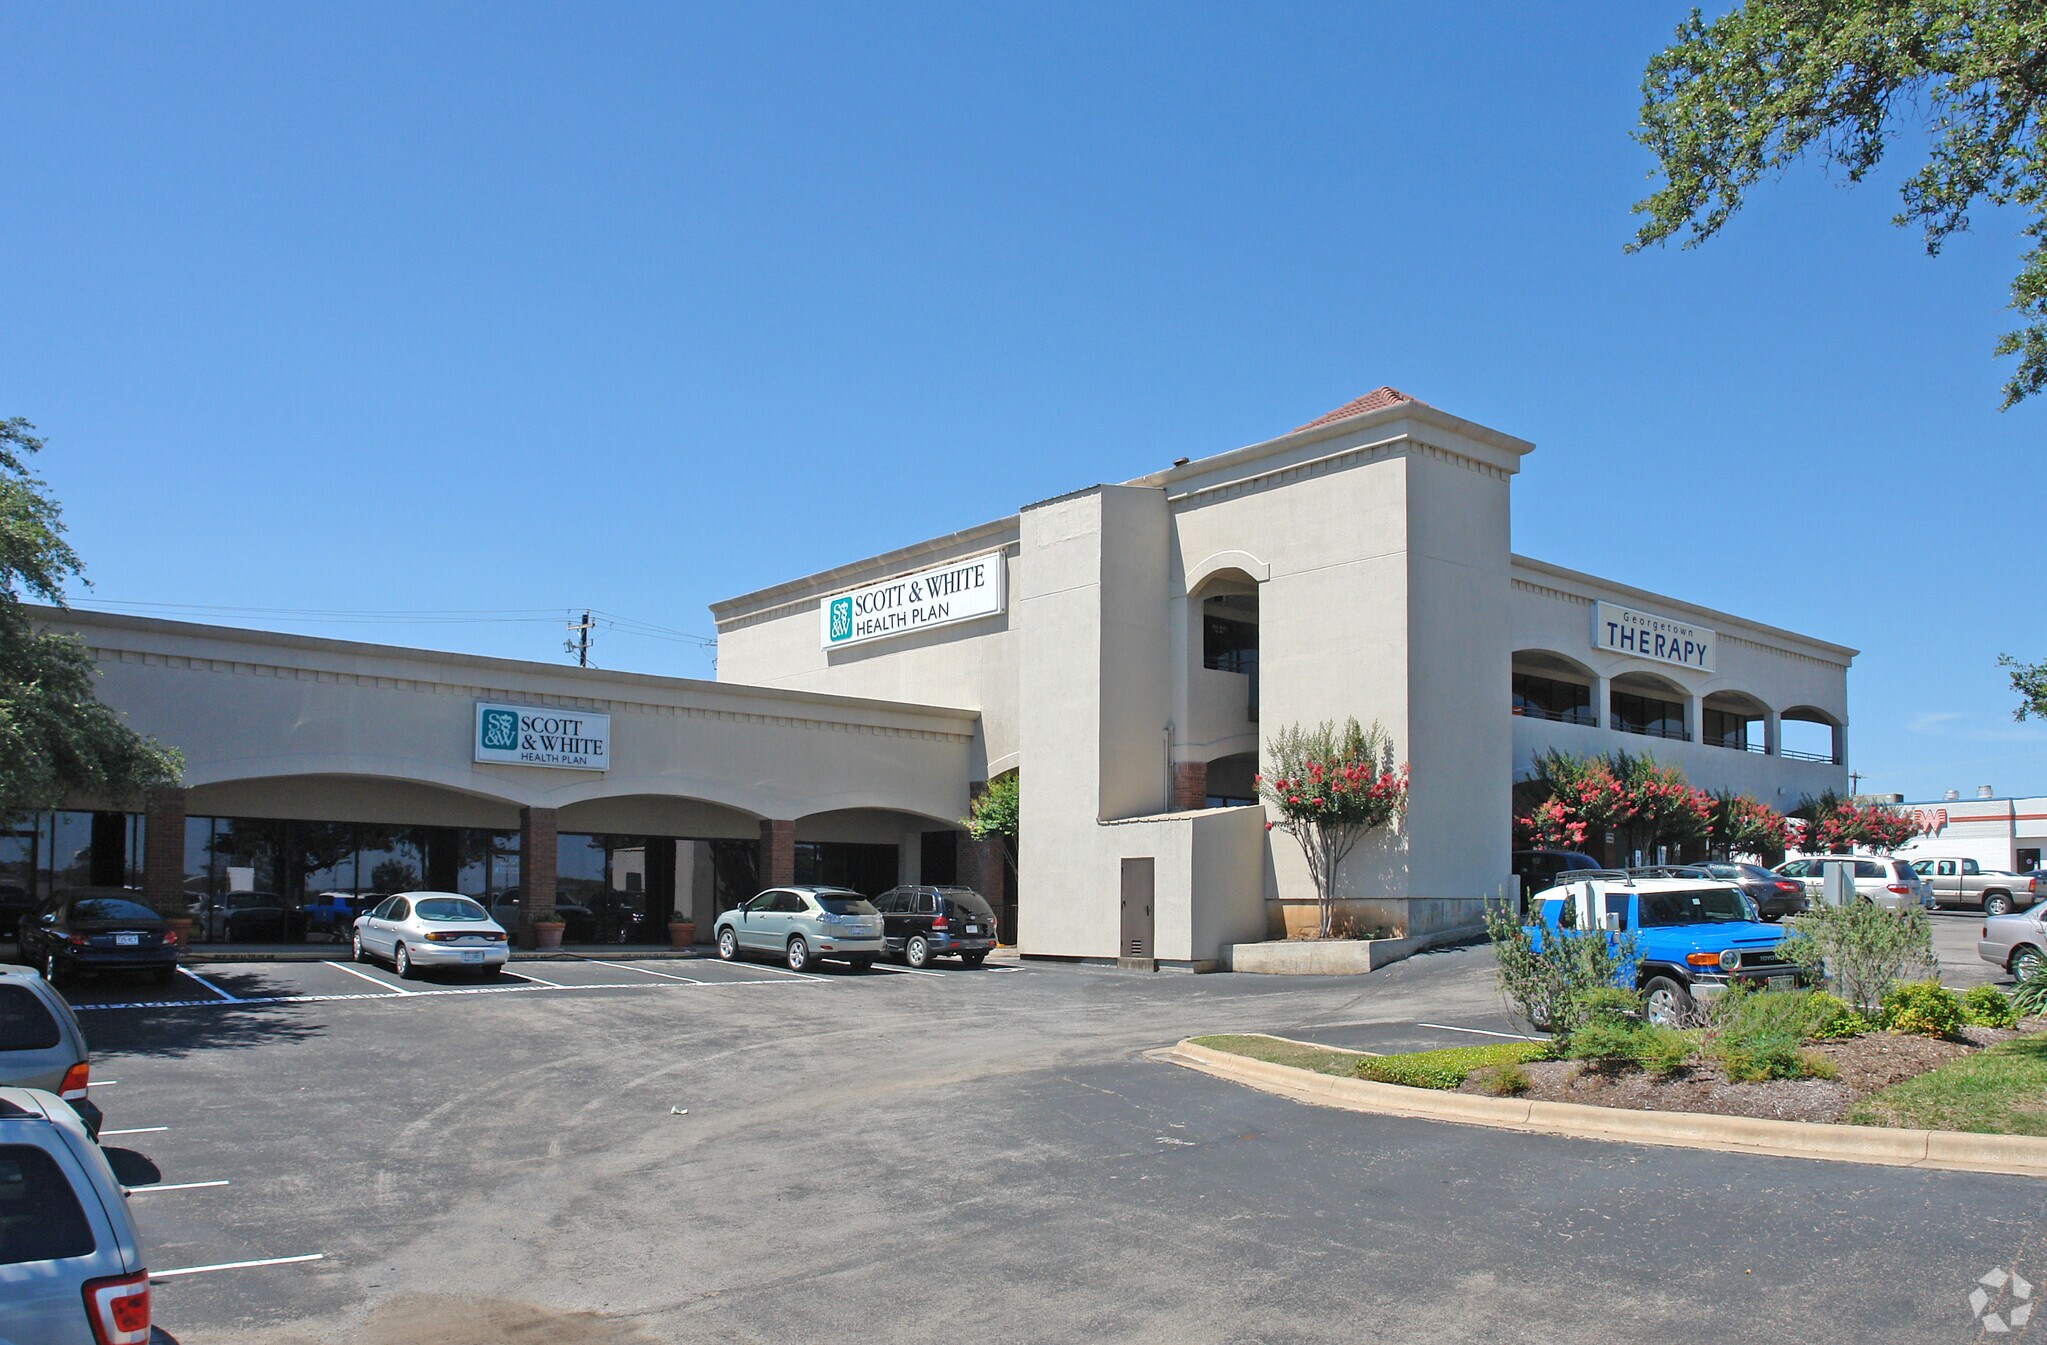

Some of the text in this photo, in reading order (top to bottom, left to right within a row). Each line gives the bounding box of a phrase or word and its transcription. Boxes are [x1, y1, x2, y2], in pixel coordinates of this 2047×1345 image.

[855, 564, 985, 616] SCOTT & WHITE
[856, 602, 949, 637] HEALTH PLAN
[1623, 612, 1694, 637] Georgetown
[1607, 621, 1707, 666] THERAPY
[521, 716, 583, 736] SCOTT
[521, 734, 604, 756] & WHITE
[521, 752, 587, 765] HEALTH PLAN
